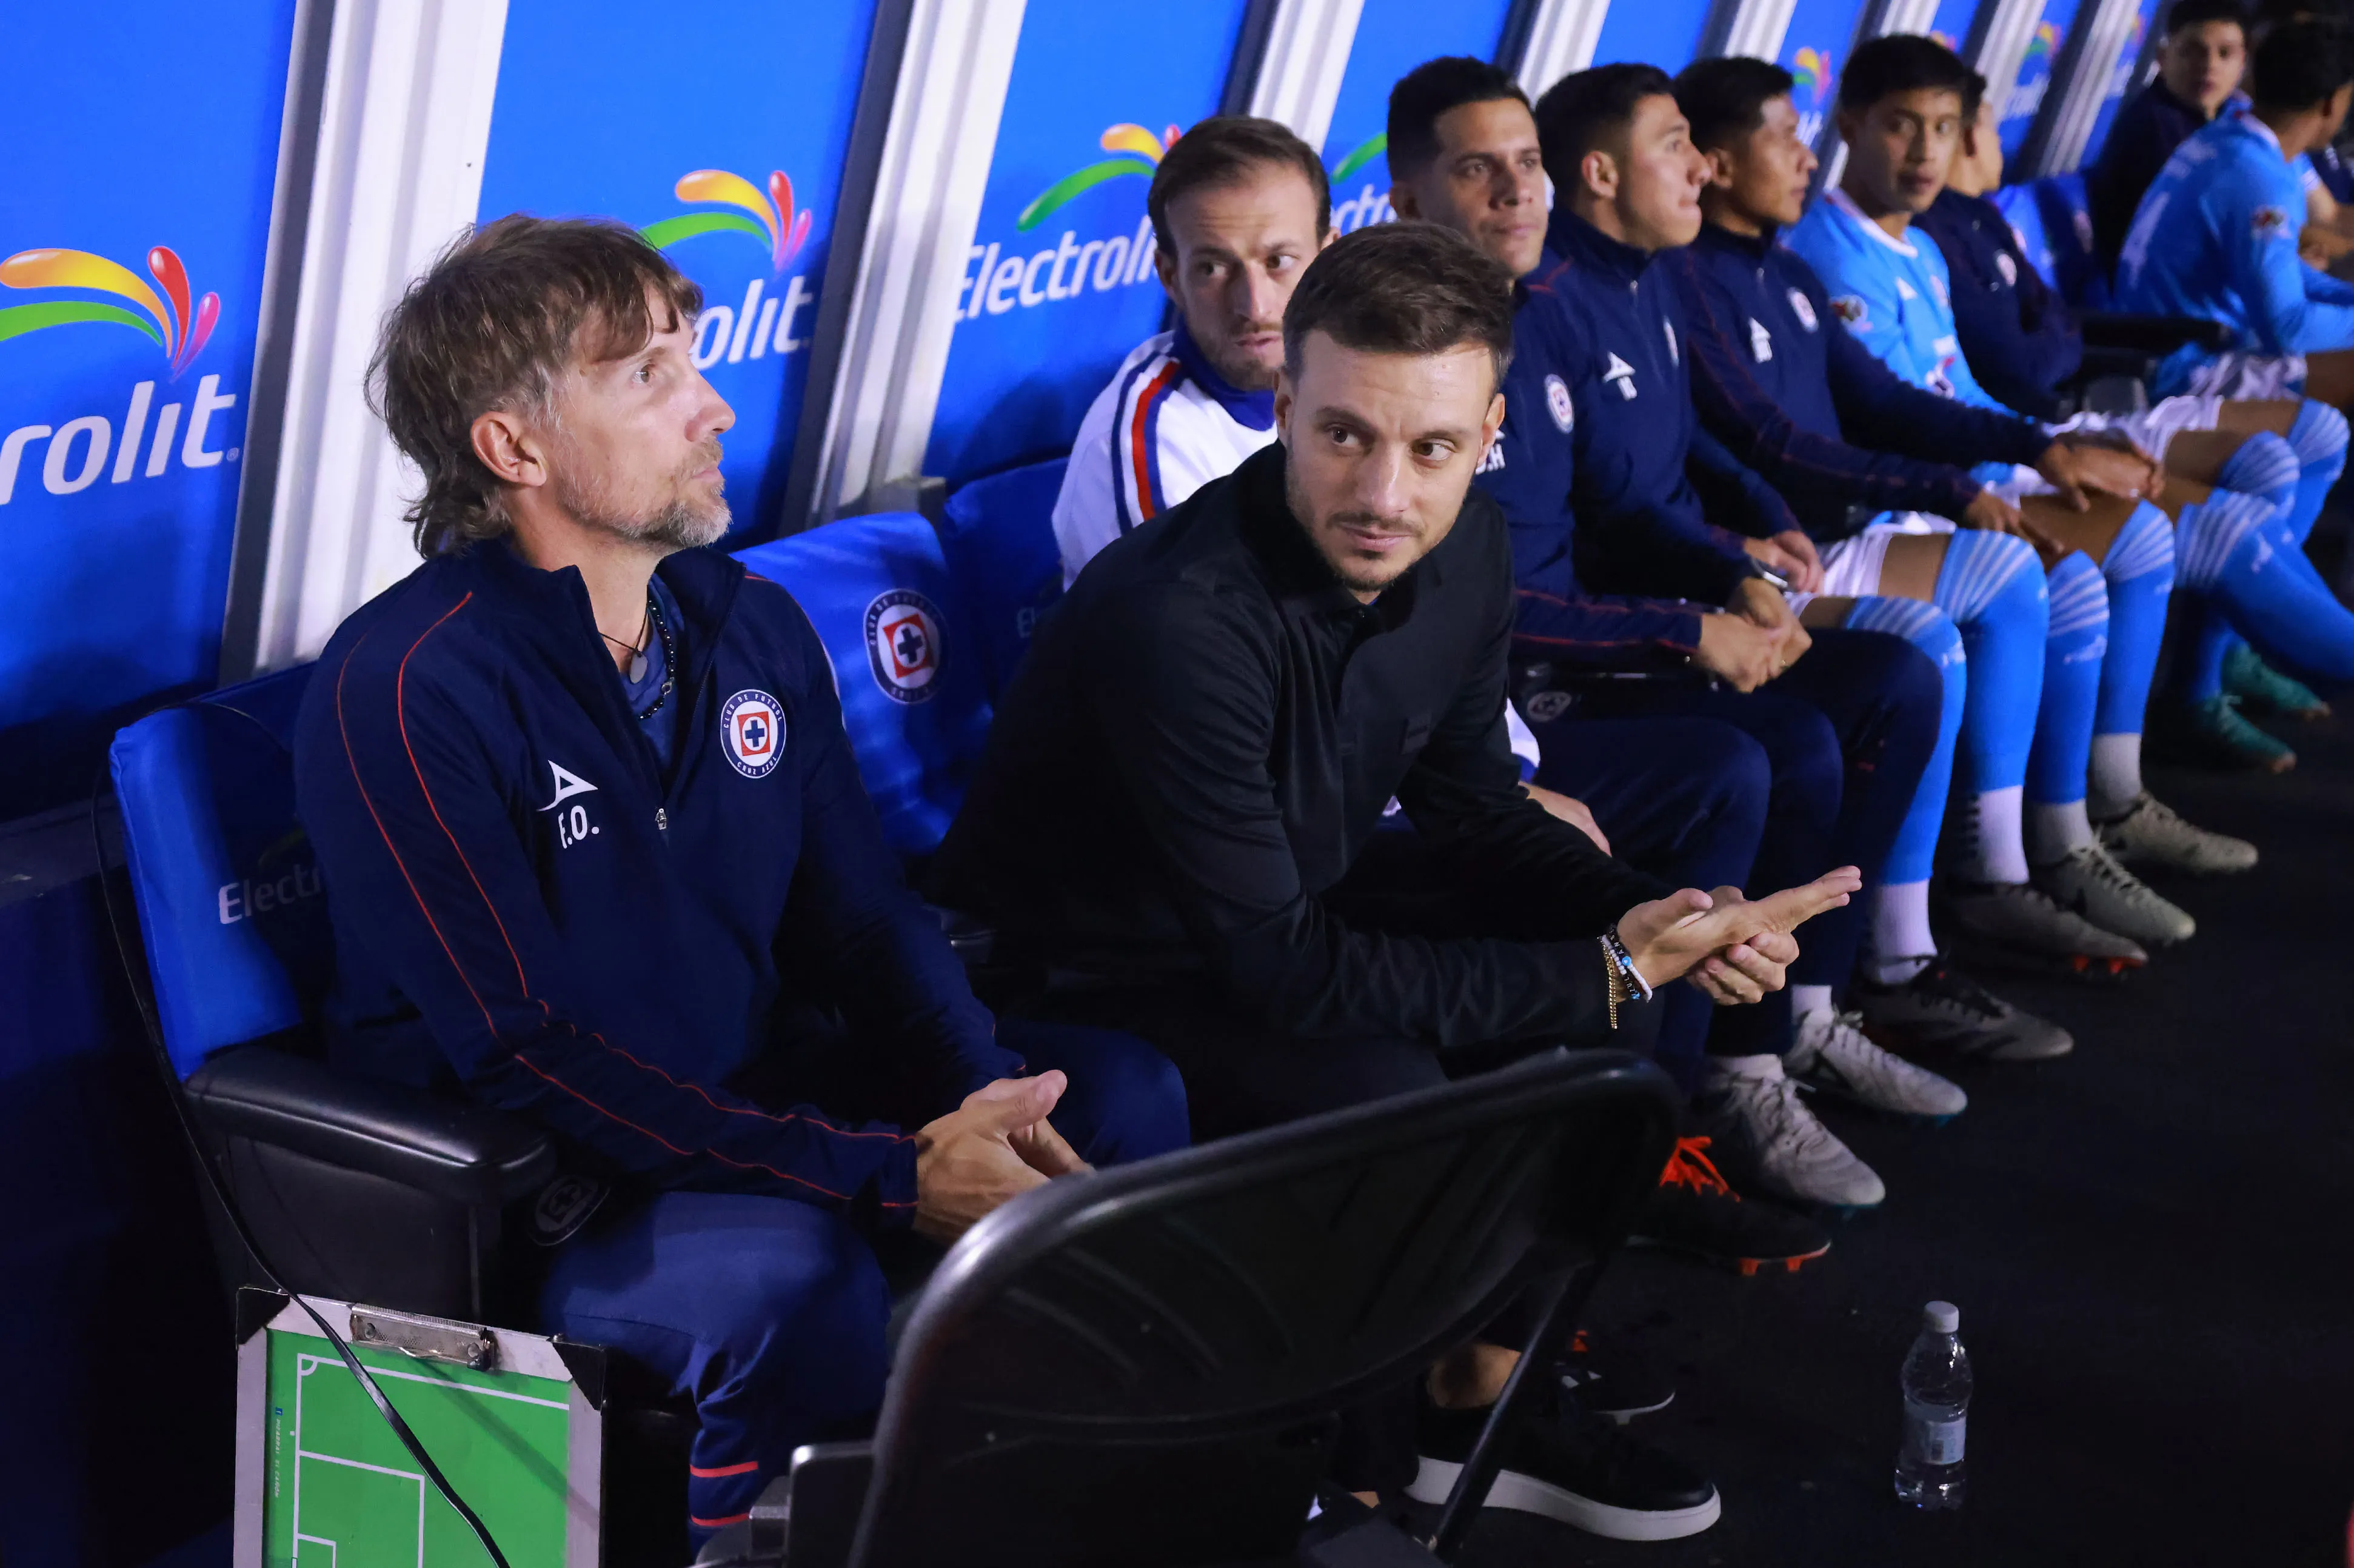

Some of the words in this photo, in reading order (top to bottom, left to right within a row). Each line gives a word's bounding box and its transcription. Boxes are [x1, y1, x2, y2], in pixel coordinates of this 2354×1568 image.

[723, 704, 735, 729] CLUB
[737, 694, 749, 702] DE
[755, 693, 783, 721] FUTBOL
[737, 761, 757, 775] CRUZ
[761, 756, 777, 773] AZUL
[558, 805, 600, 849] F.O.
